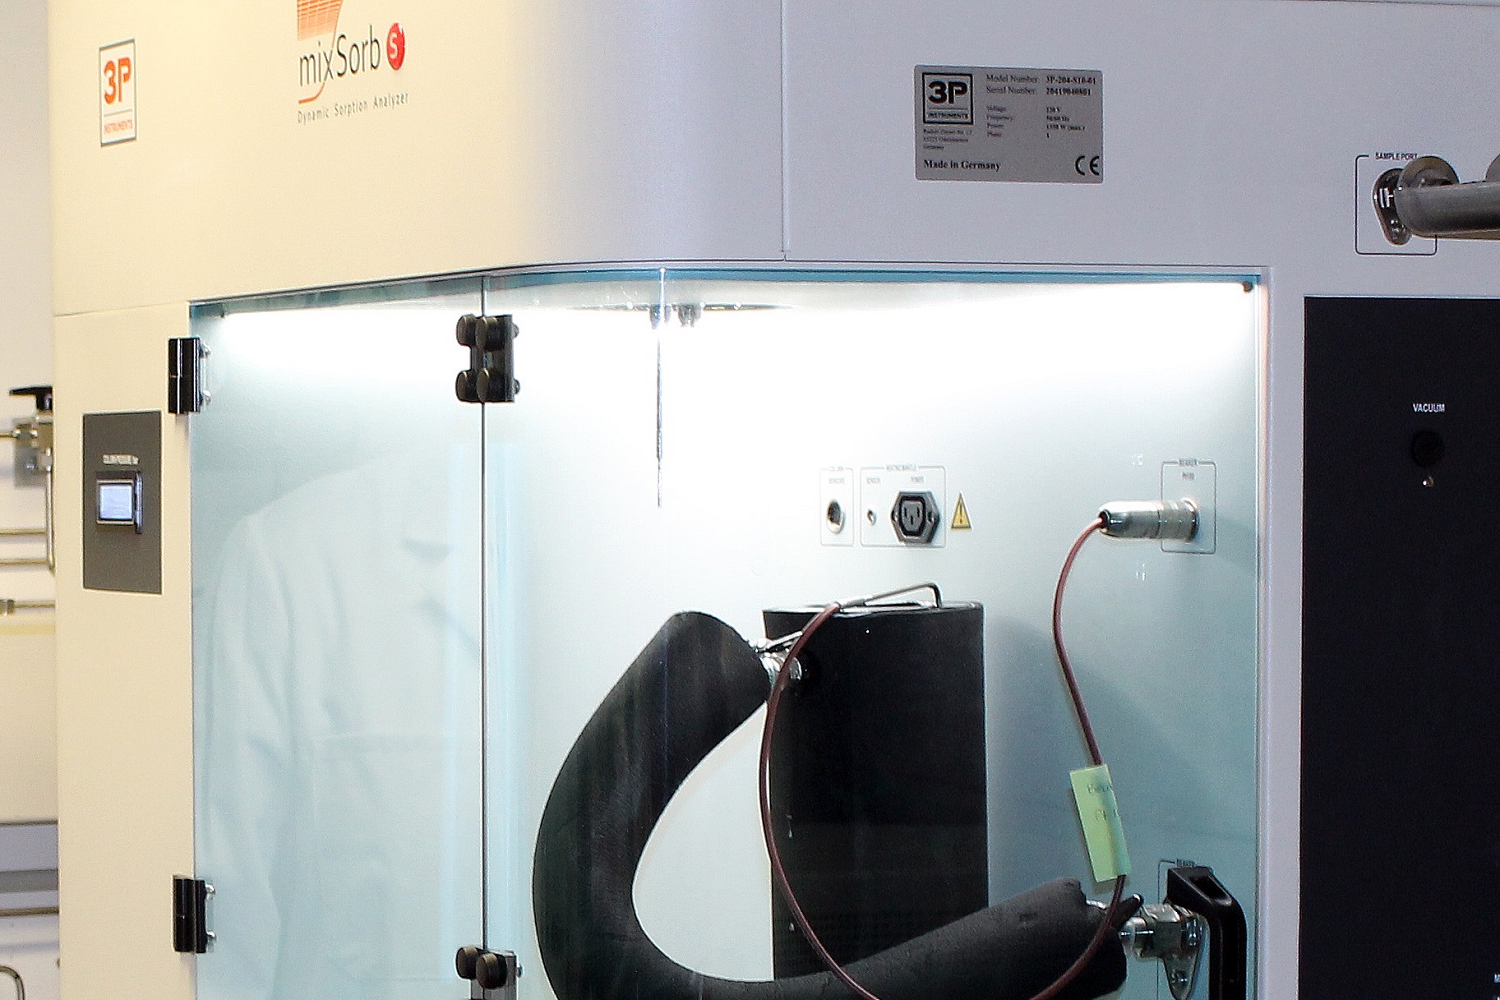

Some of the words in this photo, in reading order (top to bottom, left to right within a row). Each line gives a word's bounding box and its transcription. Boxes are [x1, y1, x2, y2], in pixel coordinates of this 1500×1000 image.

[299, 23, 381, 87] mixSorb
[103, 56, 132, 105] 3P
[928, 81, 968, 105] 3P
[297, 107, 330, 126] Dynamic
[334, 100, 369, 118] Sorption
[373, 91, 409, 110] Analyzer
[924, 159, 948, 170] Made
[950, 160, 959, 169] in
[961, 160, 1000, 172] Germany
[1412, 403, 1446, 413] VACUUM
